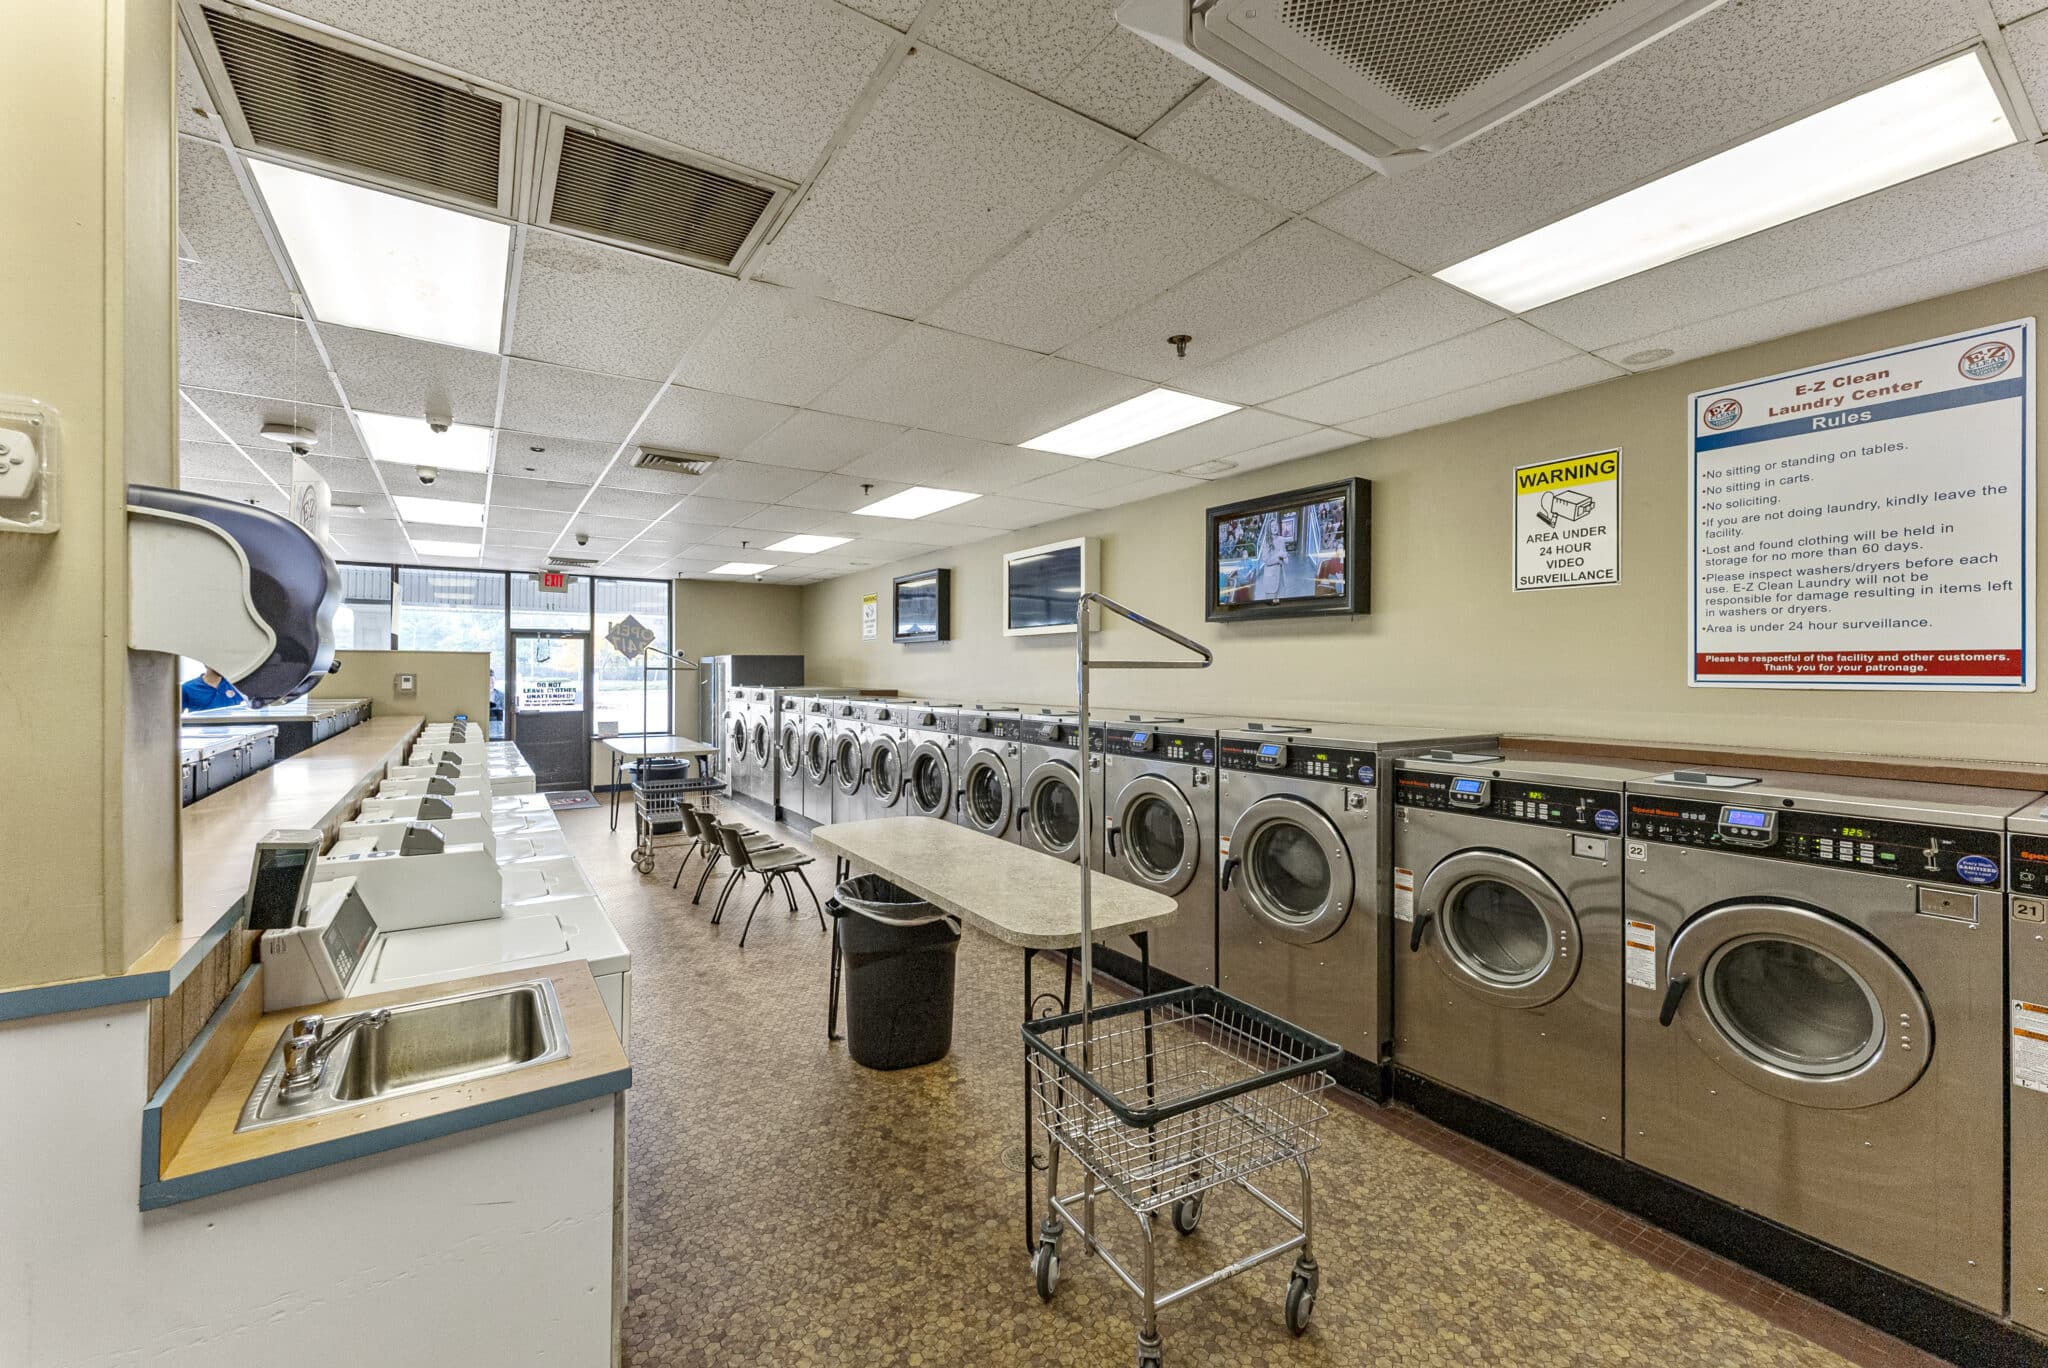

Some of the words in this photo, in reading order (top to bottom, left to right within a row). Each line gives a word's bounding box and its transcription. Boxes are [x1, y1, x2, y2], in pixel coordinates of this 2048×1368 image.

[1795, 381, 1826, 396] E-Z
[1832, 368, 1889, 388] Clean
[1768, 395, 1844, 417] Laundry
[1852, 380, 1922, 400] Center
[1812, 411, 1872, 430] Rules
[1706, 470, 1722, 479] No
[1726, 464, 1760, 476] sitting
[1765, 462, 1777, 470] or
[1781, 453, 1835, 467] standing
[1840, 450, 1856, 459] on
[1862, 442, 1908, 456] tables.
[1520, 460, 1615, 488] WARNING
[1706, 486, 1722, 495] No
[1726, 480, 1760, 491] sitting
[1765, 478, 1774, 487] in
[1780, 474, 1814, 484] carts.
[1706, 502, 1722, 511] No
[1726, 495, 1780, 509] soliciting.
[1706, 517, 1713, 527] If
[1717, 517, 1737, 528] you
[1742, 514, 1760, 522] are
[1765, 511, 1784, 520] not
[1788, 506, 1822, 518] doing
[1828, 500, 1880, 514] laundry,
[1886, 494, 1928, 506] kindly
[1934, 490, 1976, 501] leave
[1983, 485, 2007, 496] the
[1526, 532, 1559, 544] AREA
[1563, 526, 1606, 539] UNDER
[1706, 528, 1743, 539] facility.
[1706, 545, 1730, 554] Lost
[1734, 542, 1754, 552] and
[1760, 539, 1793, 550] found
[1798, 534, 1848, 547] clothing
[1854, 531, 1875, 541] will
[1881, 529, 1898, 539] be
[1904, 525, 1934, 537] held
[1941, 524, 1954, 533] in
[1540, 548, 1552, 556] 24
[1556, 542, 1592, 554] HOUR
[1706, 556, 1747, 567] storage
[1752, 553, 1768, 562] for
[1772, 552, 1786, 561] no
[1792, 550, 1823, 559] more
[1828, 547, 1856, 556] than
[1863, 543, 1879, 554] 60
[1885, 541, 1923, 552] days.
[1546, 557, 1584, 569] VIDEO
[1706, 572, 1744, 582] Please
[1749, 568, 1792, 580] inspect
[1797, 561, 1900, 576] washers/dryers
[1906, 558, 1954, 569] before
[1960, 553, 1998, 564] each
[544, 574, 563, 587] EXIT
[1520, 569, 1613, 585] SURVEILLANCE
[1734, 583, 1754, 592] E-Z
[1758, 580, 1792, 591] Clean
[1798, 577, 1850, 588] Laundry
[1856, 575, 1877, 585] will
[1883, 574, 1905, 583] not
[1911, 572, 1928, 581] be
[1706, 594, 1772, 606] responsible
[1776, 593, 1792, 602] for
[1796, 590, 1848, 601] damage
[1854, 586, 1914, 598] resulting
[1921, 585, 1933, 594] in
[1940, 583, 1981, 594] items
[1988, 580, 2013, 591] left
[1706, 608, 1714, 617] in
[1719, 605, 1767, 617] washers
[1771, 606, 1784, 614] or
[1788, 604, 1832, 616] dryers.
[1706, 624, 1732, 633] Area
[1737, 624, 1746, 632] is
[1750, 622, 1784, 632] under
[1789, 621, 1803, 631] 24
[1808, 620, 1837, 630] hour
[1843, 618, 1932, 629] surveillance.
[1752, 654, 1801, 663] respectful
[1837, 654, 1873, 663] facility
[1938, 653, 2010, 661] customers.
[1865, 664, 1928, 673] patronage.
[1630, 846, 1642, 855] 22
[2017, 904, 2037, 916] 21
